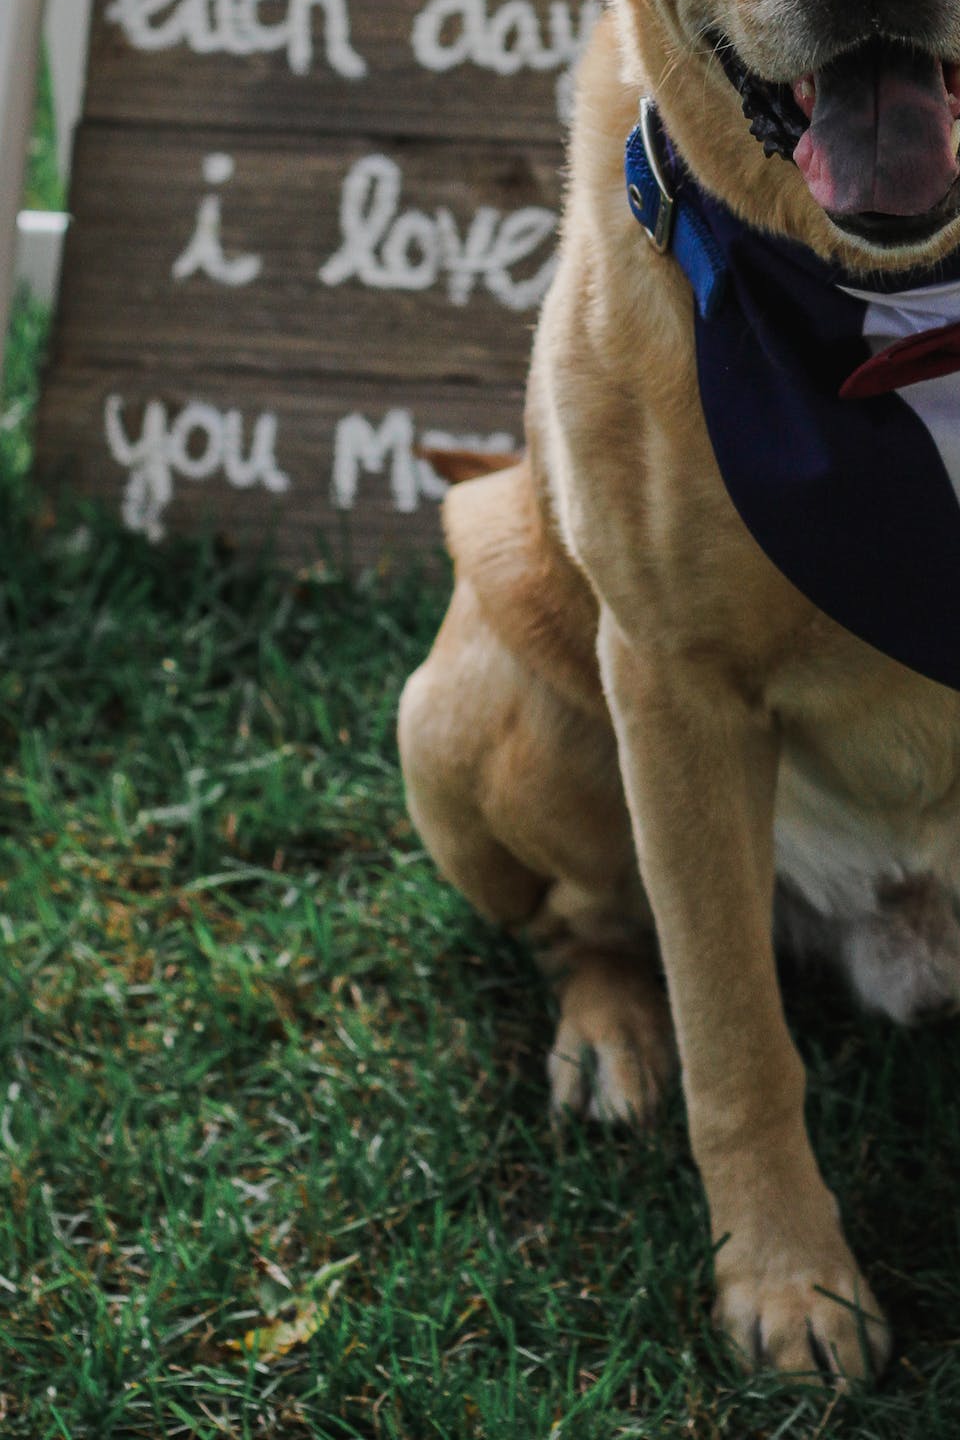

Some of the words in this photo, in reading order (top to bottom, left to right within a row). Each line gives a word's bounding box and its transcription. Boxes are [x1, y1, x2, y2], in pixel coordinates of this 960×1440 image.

[172, 154, 260, 286] i
[319, 157, 560, 311] love
[105, 394, 290, 543] you
